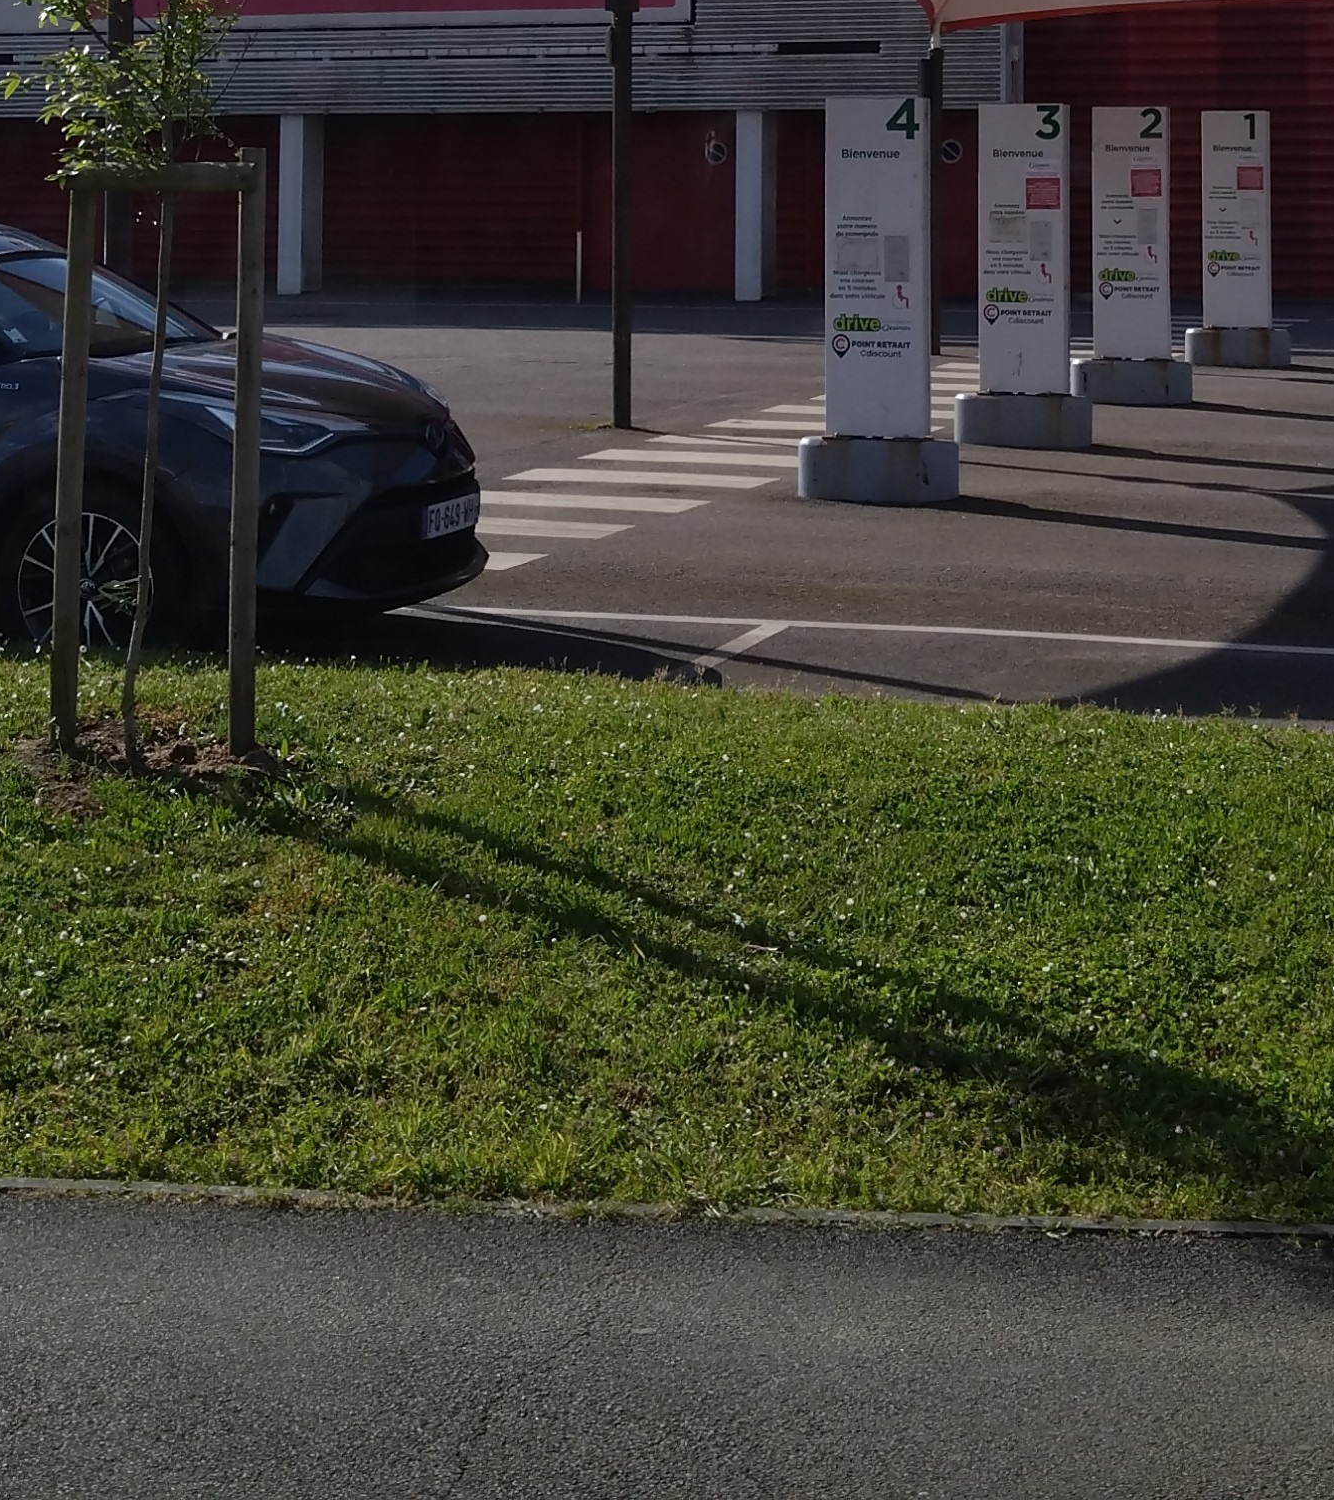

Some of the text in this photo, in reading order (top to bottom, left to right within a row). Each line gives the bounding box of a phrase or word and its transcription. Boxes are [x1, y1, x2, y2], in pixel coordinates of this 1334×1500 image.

[886, 98, 920, 140] 4
[1035, 105, 1060, 140] 3
[1140, 108, 1163, 139] 2
[1244, 113, 1255, 140] 1
[841, 148, 900, 159] Bienvenue
[992, 148, 1044, 158] Bienvenue
[1105, 144, 1150, 153] Bienvenue
[1098, 268, 1136, 281] drive
[986, 287, 1028, 303] drive
[833, 314, 881, 331] drive
[851, 340, 911, 349] POINT RETRAIT
[860, 349, 902, 358] Cdiscount
